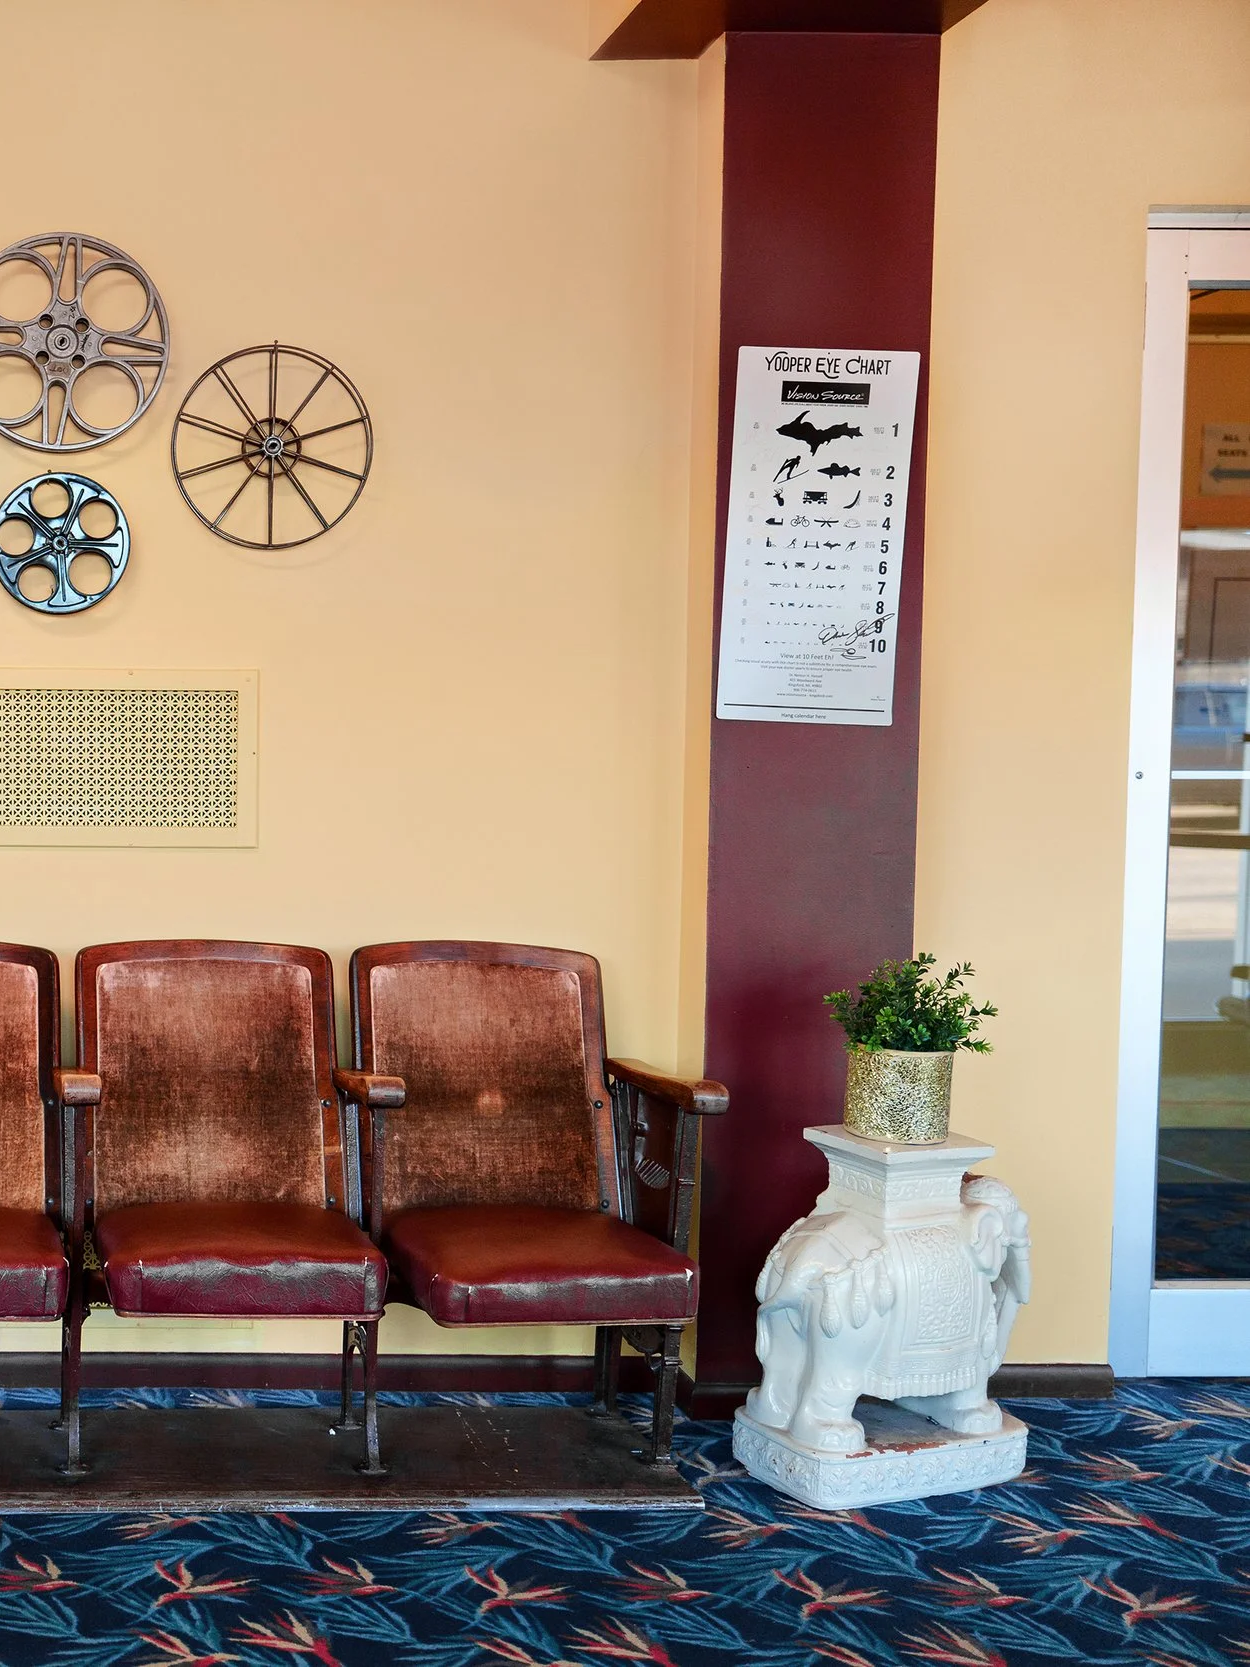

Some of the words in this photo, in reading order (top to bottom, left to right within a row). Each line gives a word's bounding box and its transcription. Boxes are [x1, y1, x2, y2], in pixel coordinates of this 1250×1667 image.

[765, 351, 811, 372] YOOPER
[816, 357, 841, 379] EYE
[845, 355, 892, 375] CHART
[892, 422, 899, 438] 1
[885, 465, 895, 480] 2
[883, 492, 893, 507] 3
[881, 516, 891, 531] 4
[880, 539, 889, 554] 5
[878, 560, 888, 575] 6
[877, 581, 886, 595] 7
[875, 600, 884, 615] 8
[869, 639, 886, 653] 10
